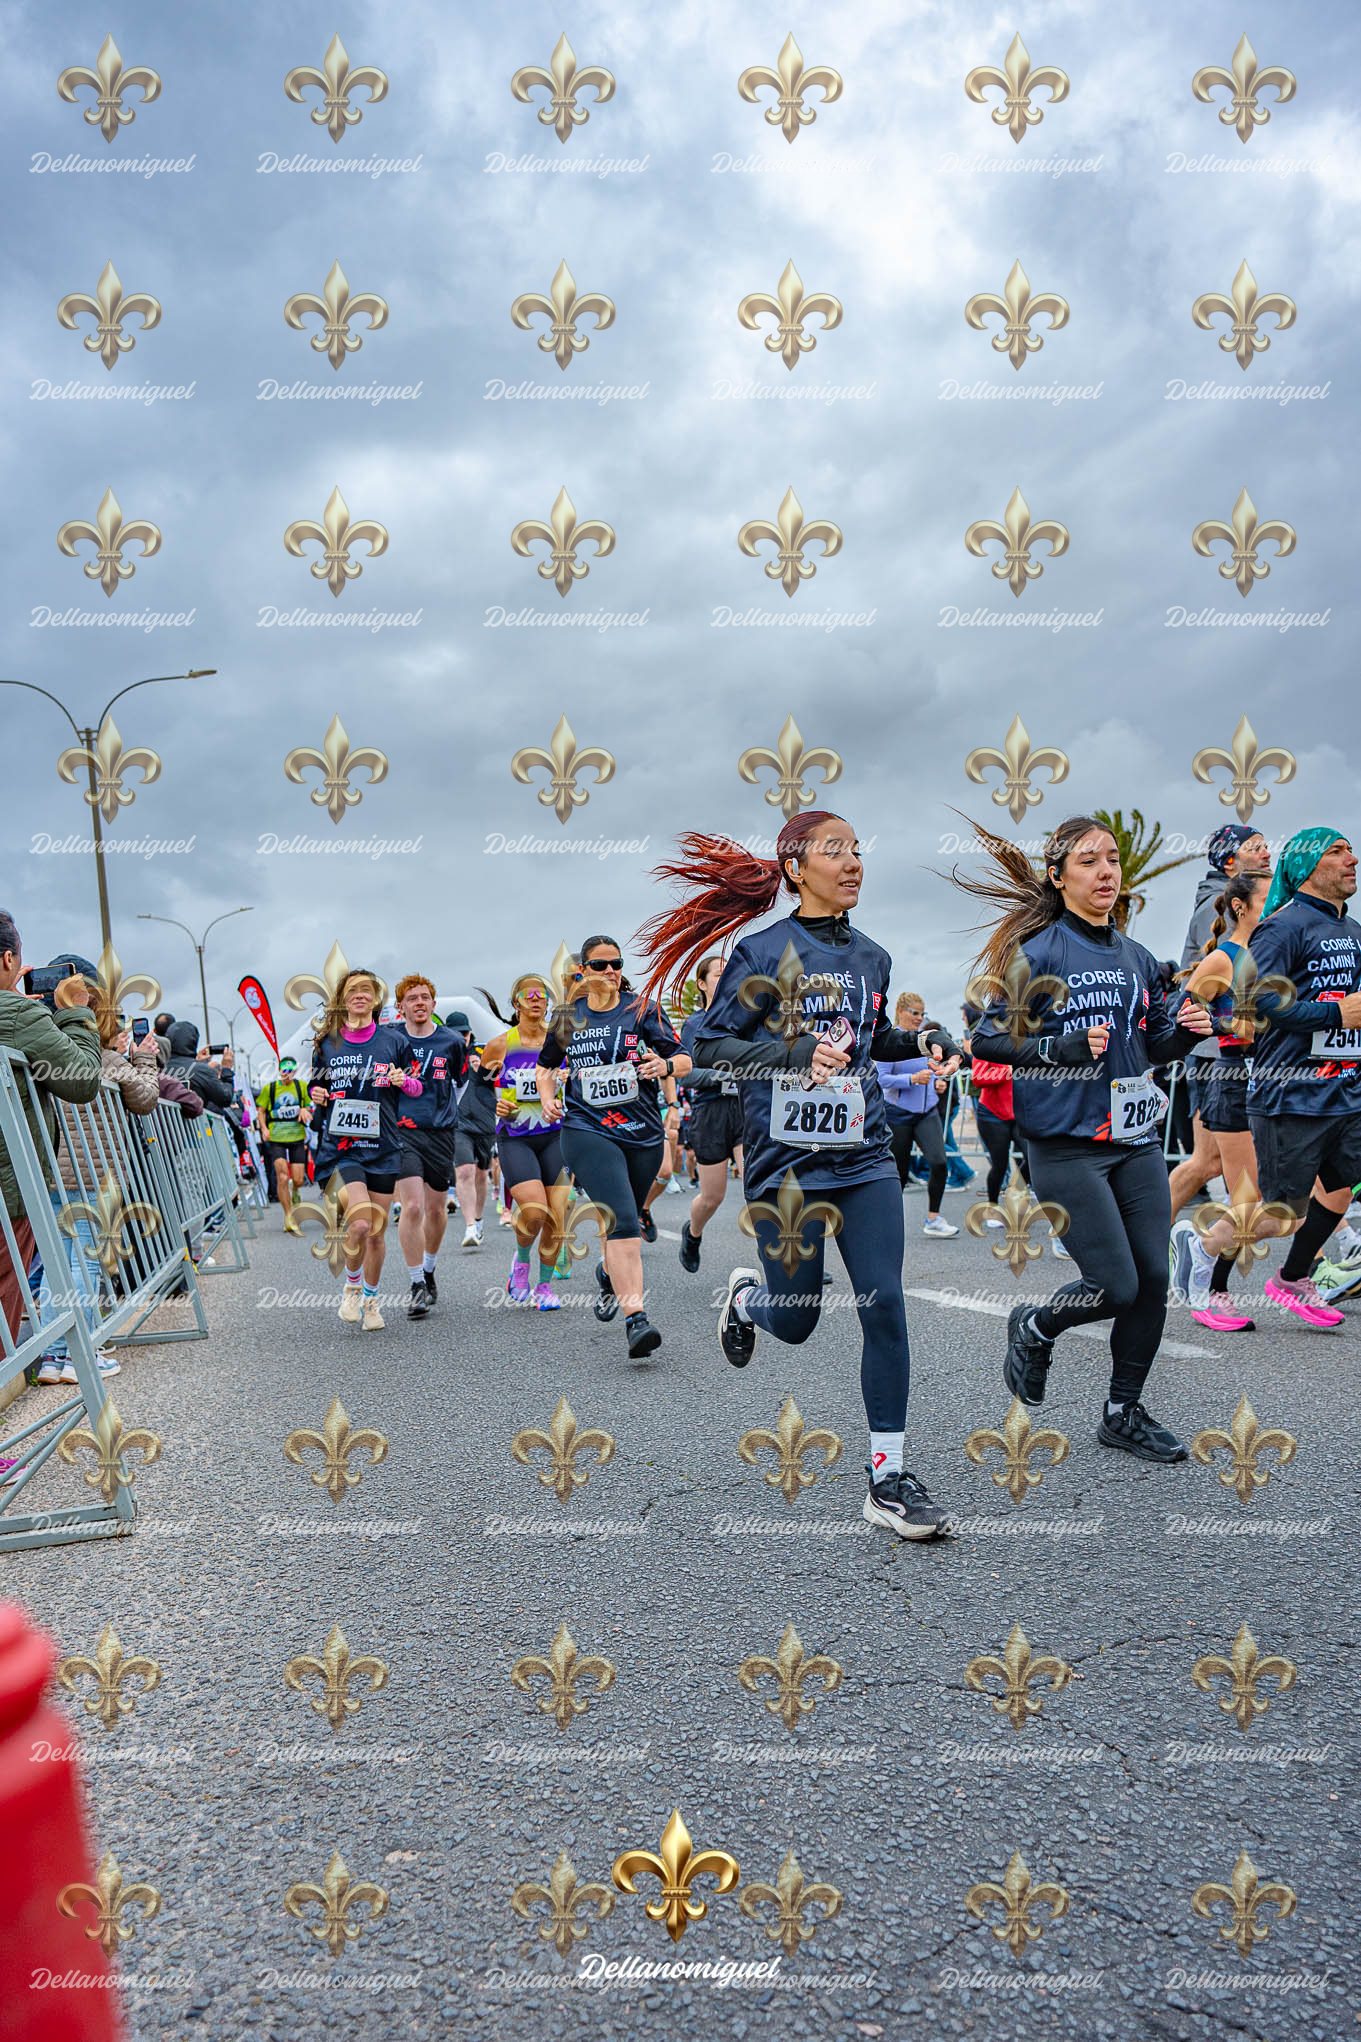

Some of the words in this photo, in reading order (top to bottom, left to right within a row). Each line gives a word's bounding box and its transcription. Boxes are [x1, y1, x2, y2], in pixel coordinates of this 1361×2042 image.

[1320, 935, 1356, 952] CORRÉ
[1307, 952, 1356, 972] CAMINÁ
[796, 970, 856, 989] CORRÉ
[1067, 968, 1127, 988] CORRÉ
[1311, 970, 1353, 989] AYUDÁ
[779, 992, 854, 1015] CAMINÁ
[1052, 988, 1123, 1015] CAMINÁ
[572, 1025, 611, 1041] CORRÉ
[1062, 1010, 1117, 1037] AYUDÁ
[329, 1053, 363, 1066] CORRÉ
[330, 1077, 353, 1090] YUDÁ
[590, 1078, 628, 1100] 2566
[337, 1112, 369, 1129] 2445
[783, 1100, 848, 1134] 2826
